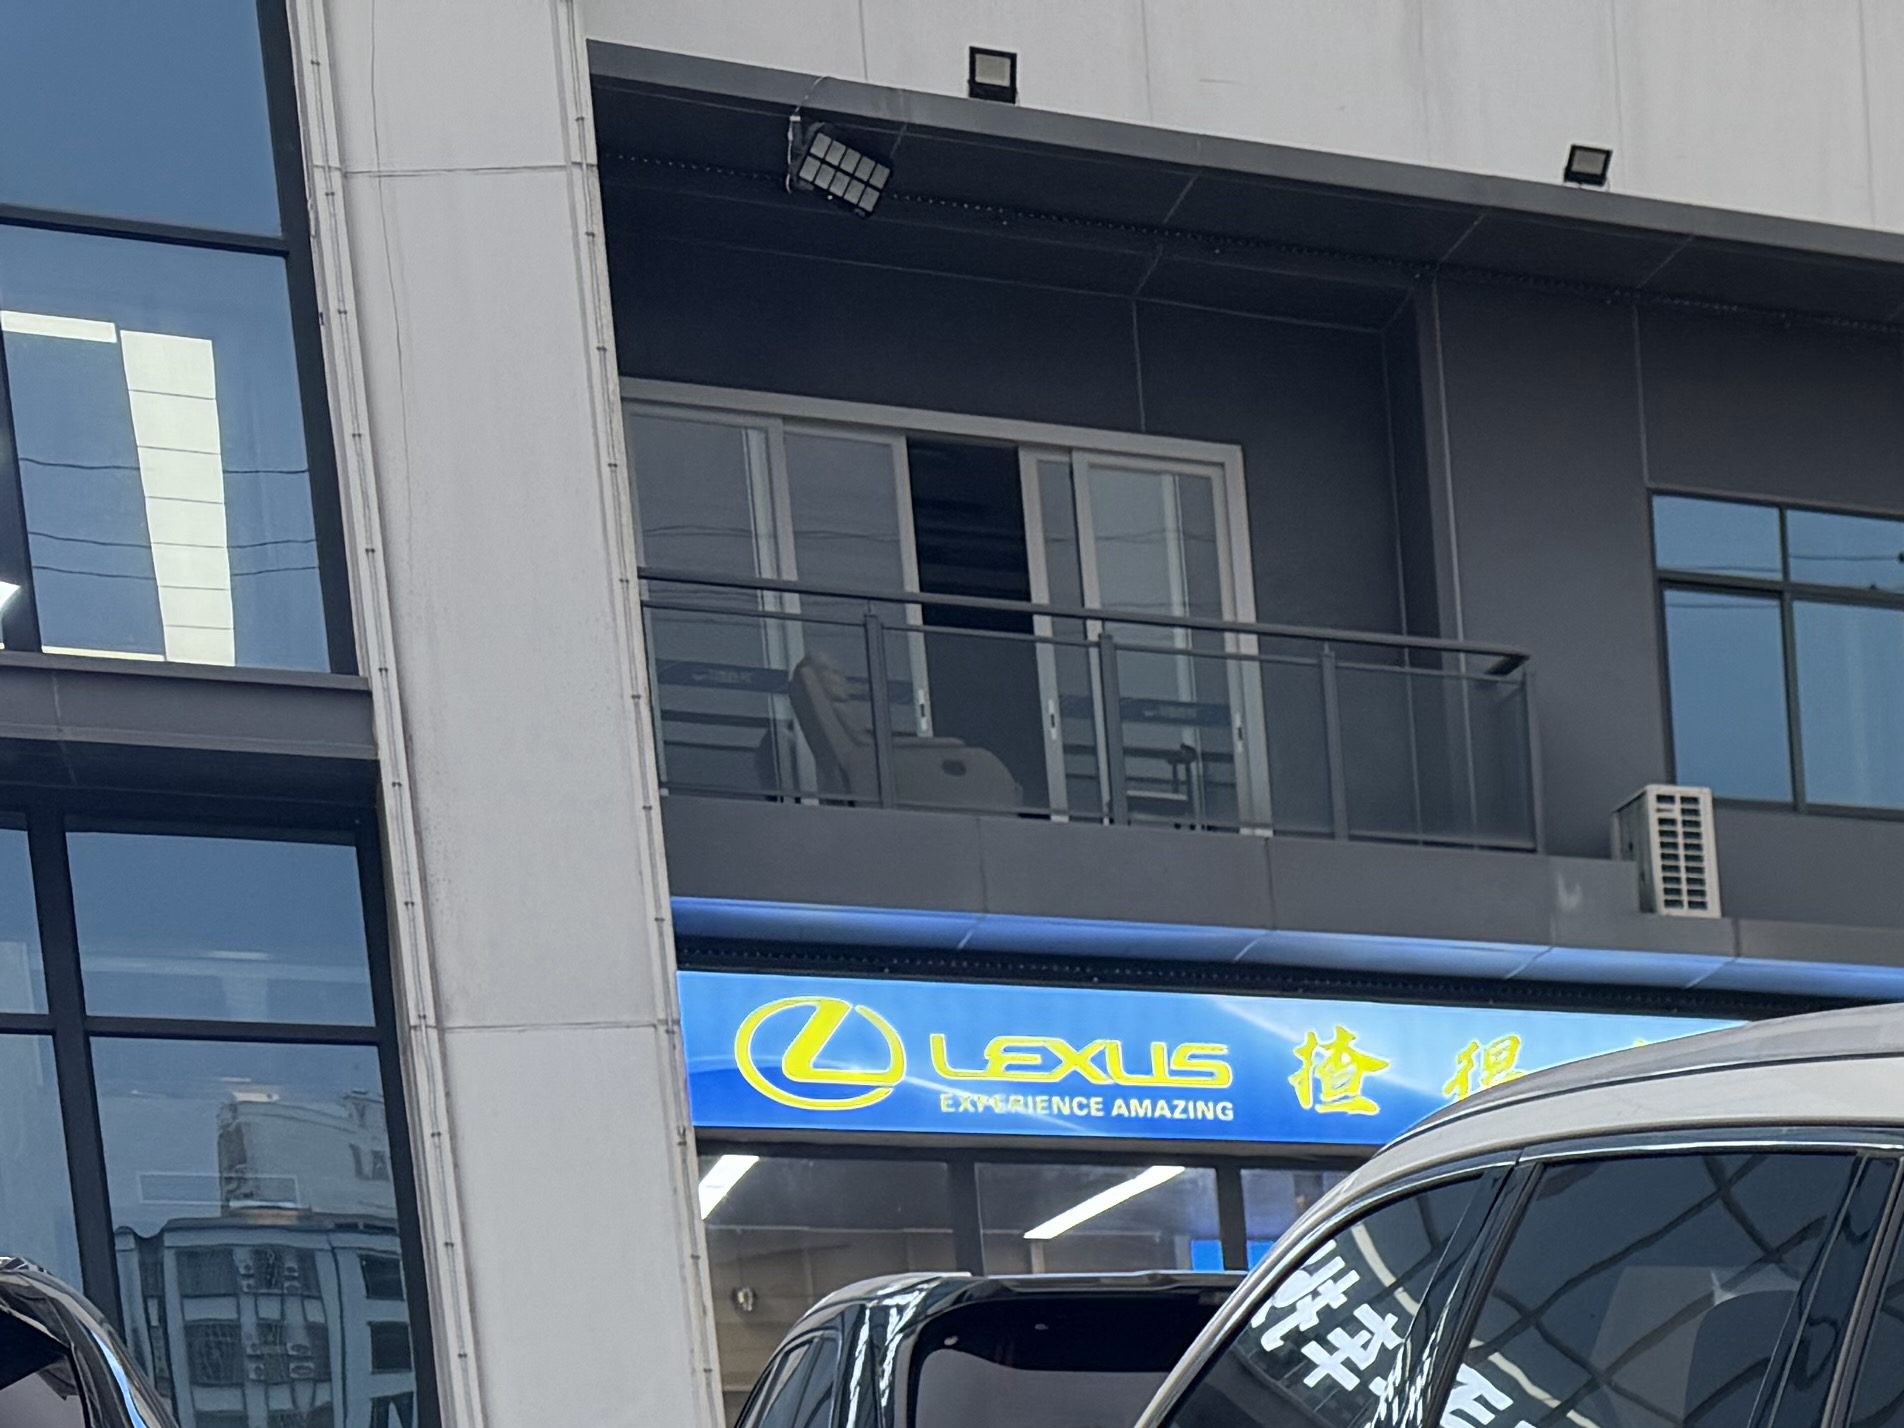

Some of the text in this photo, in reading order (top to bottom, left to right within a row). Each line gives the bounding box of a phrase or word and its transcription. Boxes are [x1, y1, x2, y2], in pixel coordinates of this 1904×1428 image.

[929, 1032, 1234, 1089] LEXUS
[940, 1092, 1235, 1122] EXPERIENCE AMAZING
